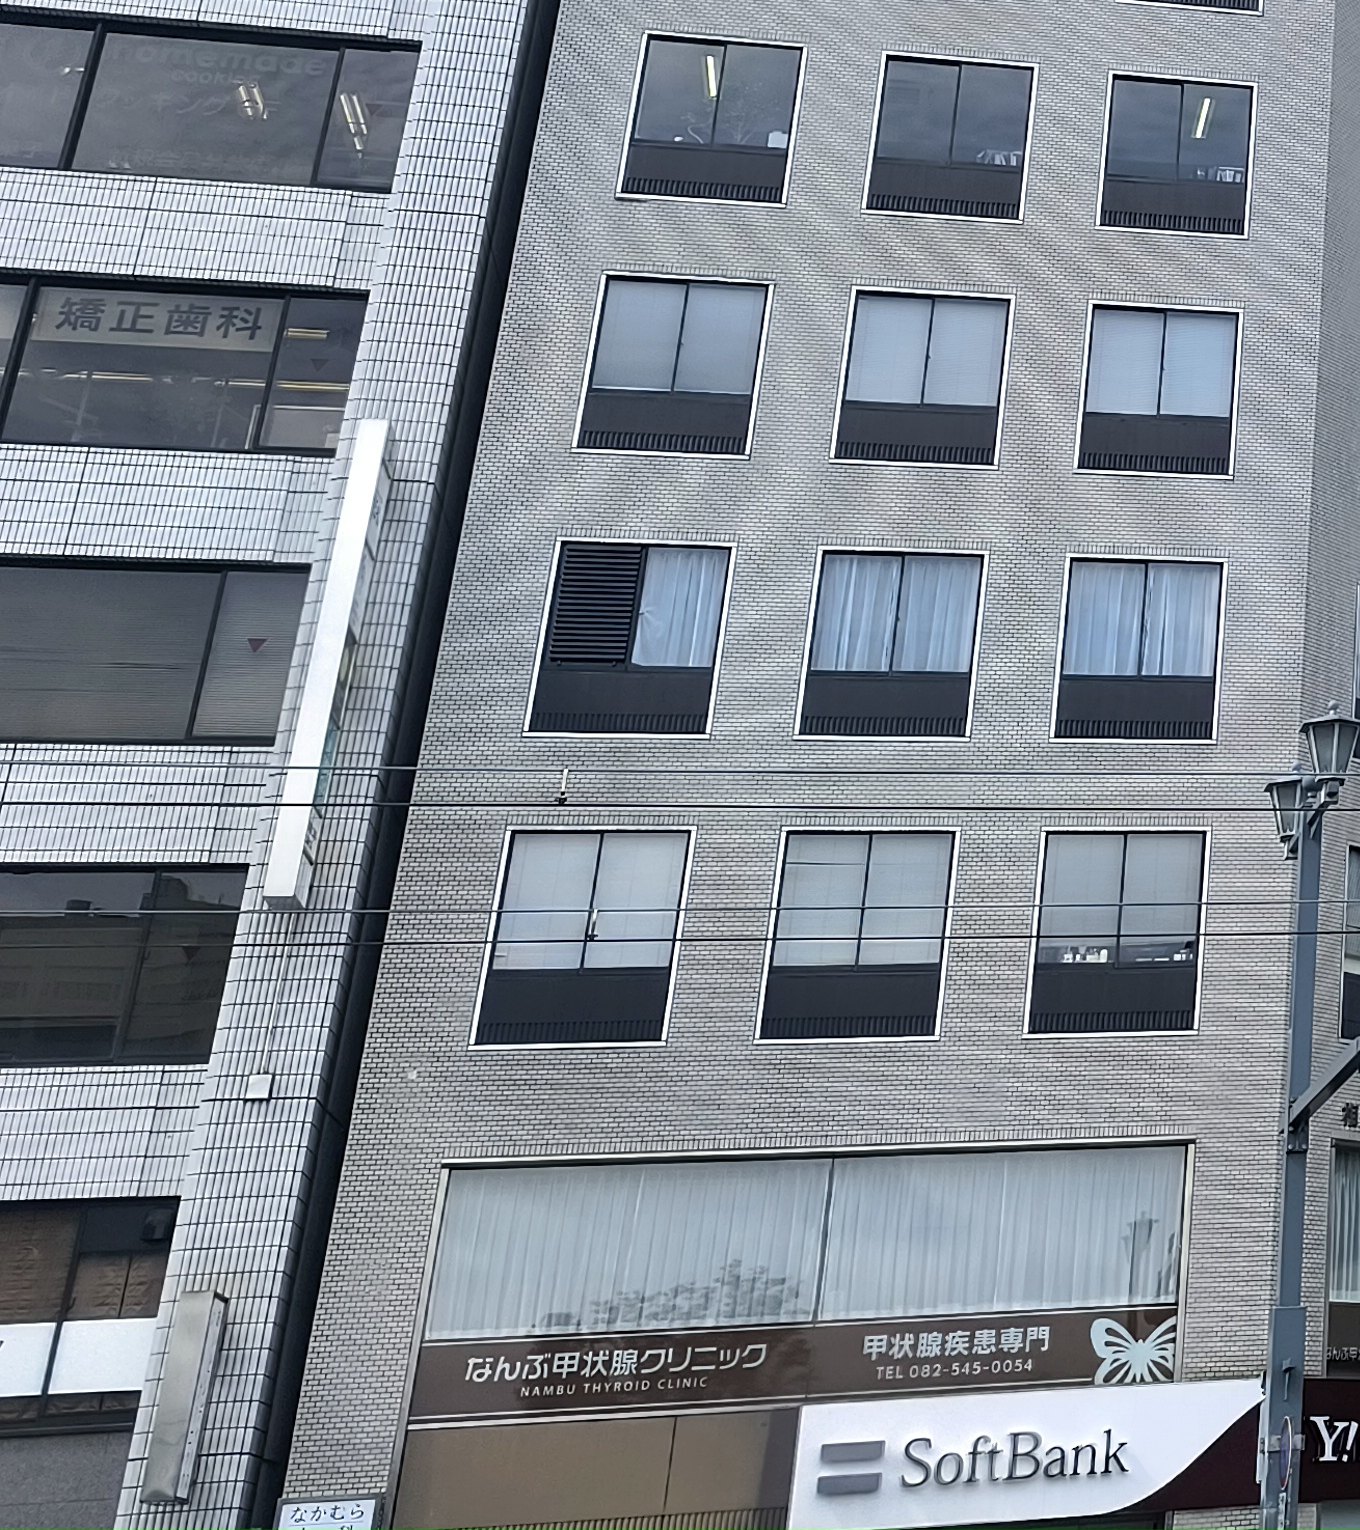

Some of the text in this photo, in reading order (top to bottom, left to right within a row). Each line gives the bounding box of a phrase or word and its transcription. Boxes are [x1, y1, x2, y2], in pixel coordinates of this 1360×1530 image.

[54, 296, 265, 342] 矯正歯科
[861, 1325, 1051, 1359] 甲状腺疾患専門
[464, 1341, 768, 1384] なんぶ甲状腺クリニック
[875, 1358, 1034, 1381] TEL 082-545-0054
[520, 1375, 708, 1398] NAMBU THYROID CLINIC
[901, 1428, 1131, 1488] SoftBank
[290, 1502, 365, 1524] なかむら
